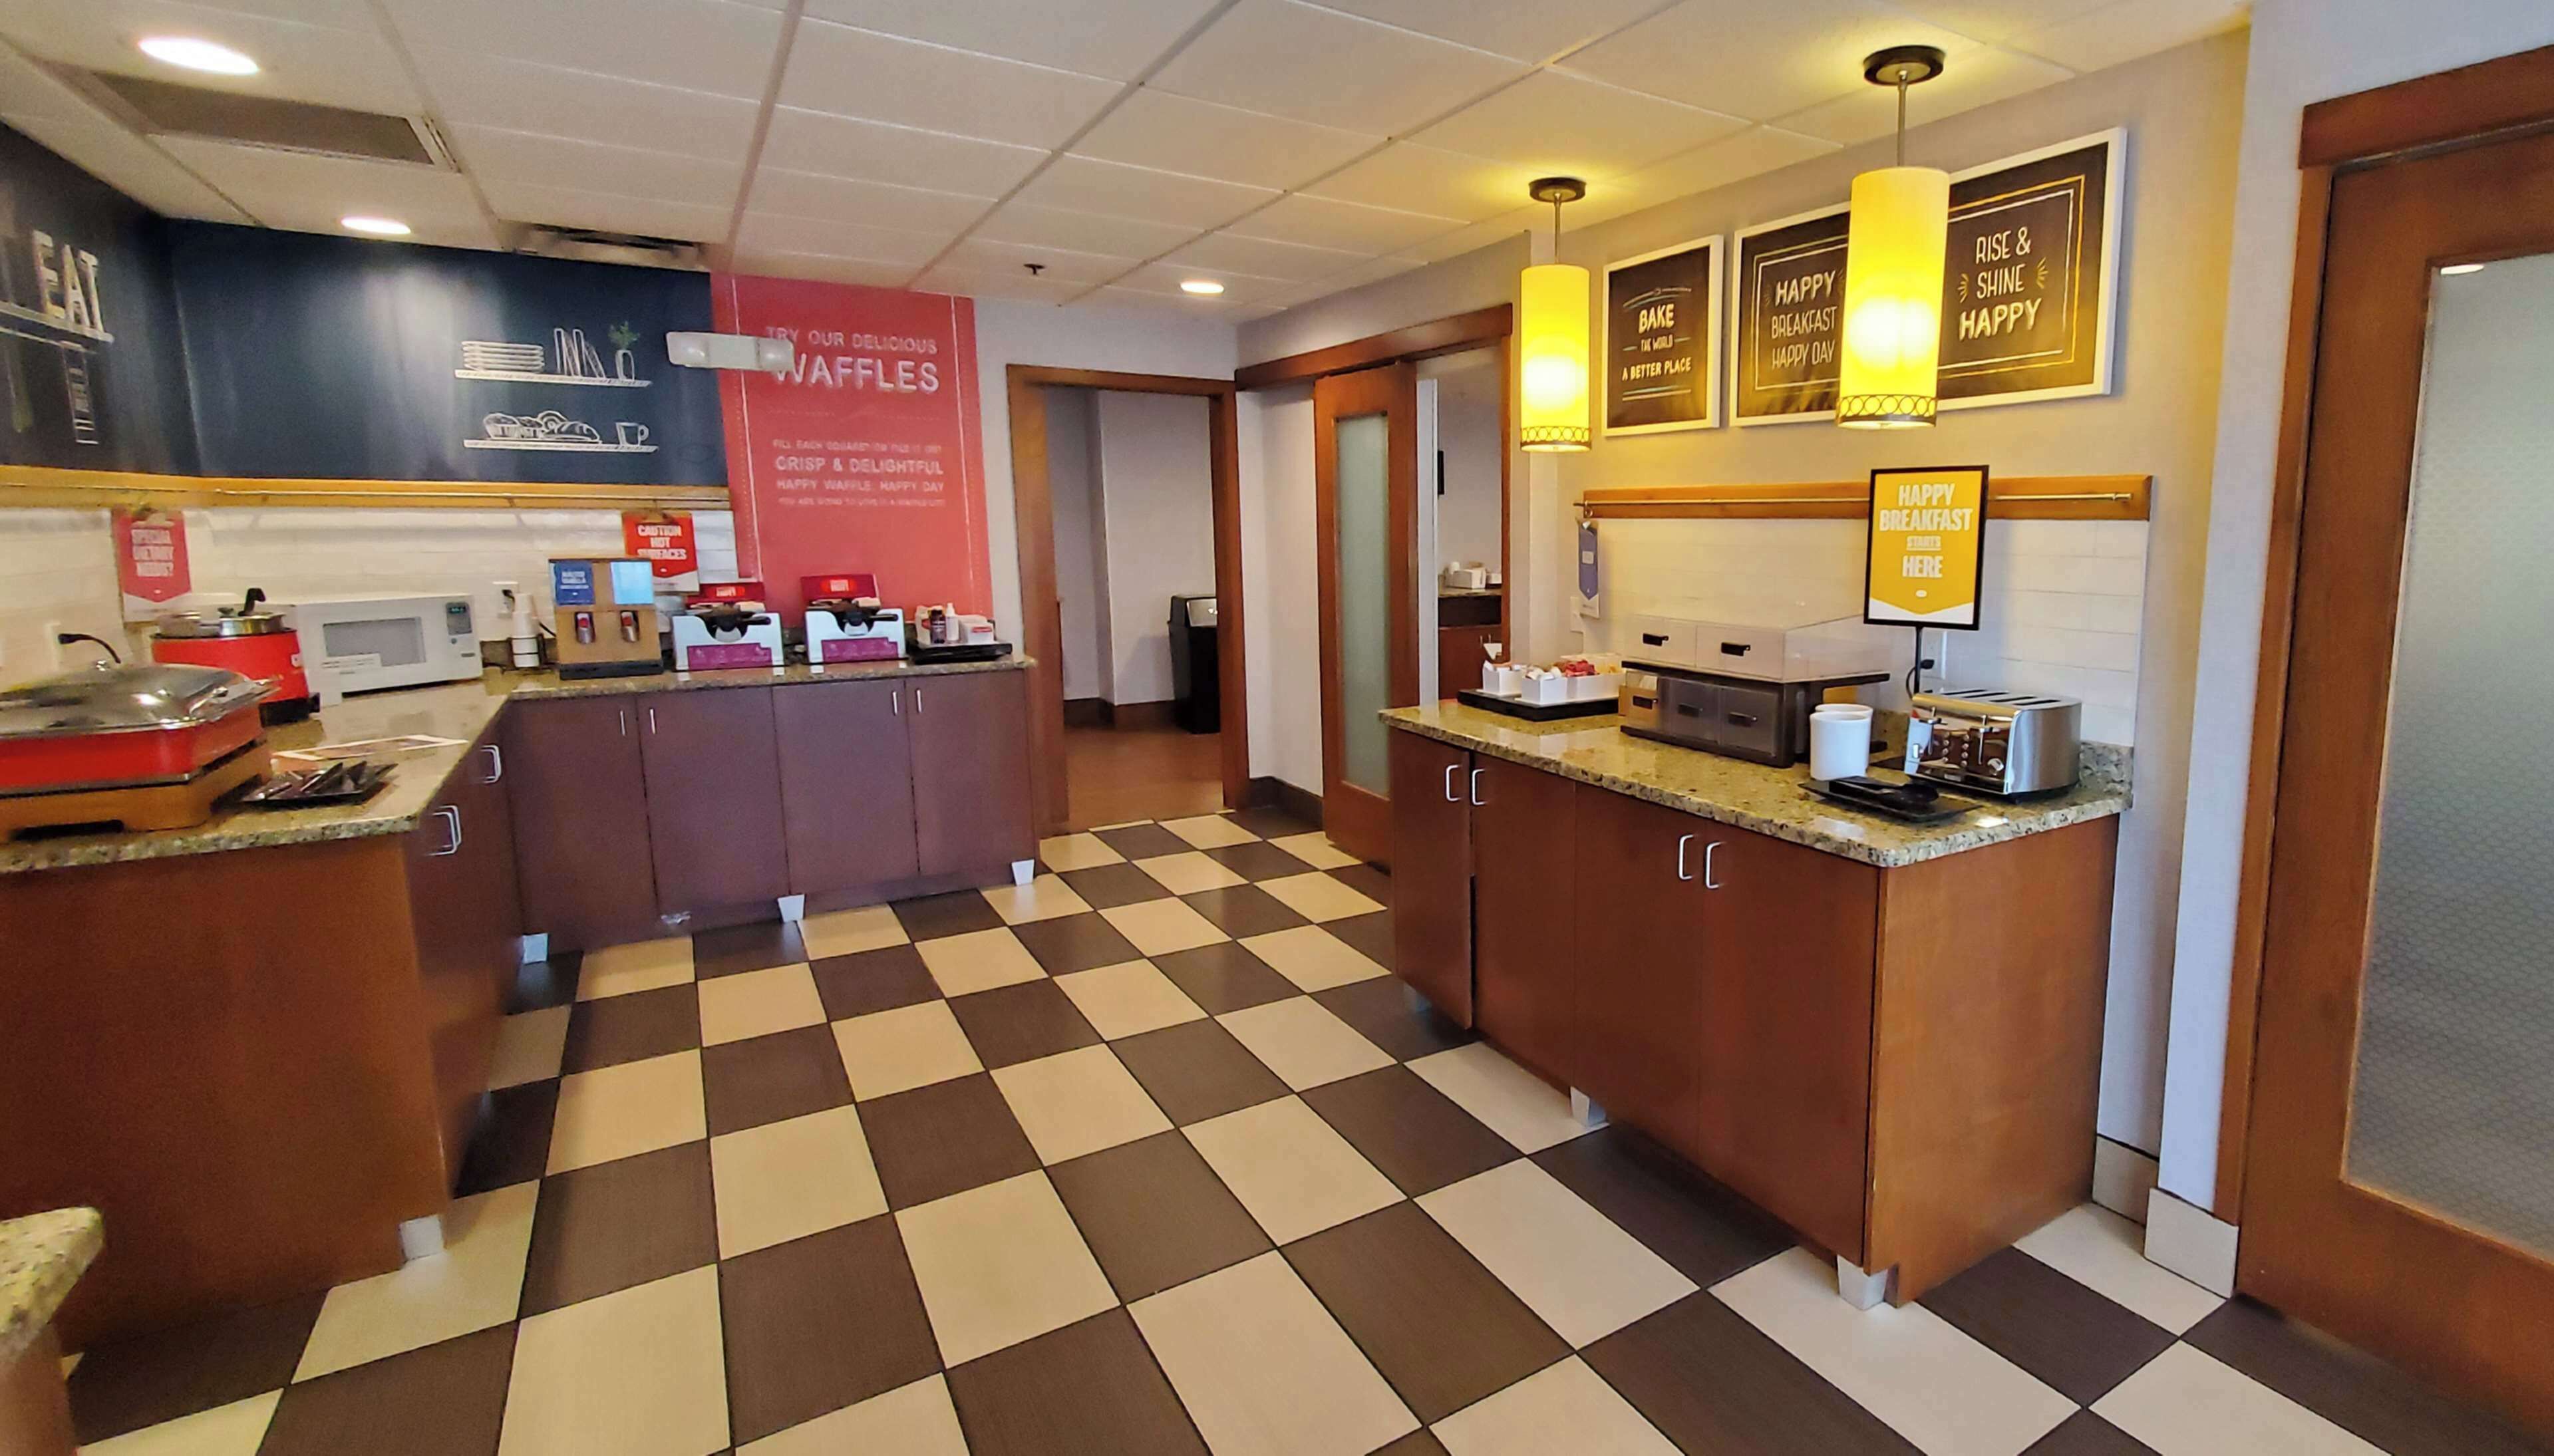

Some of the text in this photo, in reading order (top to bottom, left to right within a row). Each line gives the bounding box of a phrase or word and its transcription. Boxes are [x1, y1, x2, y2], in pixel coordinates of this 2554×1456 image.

[1976, 226, 2031, 264] RISE &
[33, 229, 104, 333] EAT
[1775, 270, 1836, 307] HAPPY
[1977, 263, 2026, 299] SHINE
[1639, 303, 1675, 334] BAKE
[1772, 306, 1837, 339] BREAKFAST
[1959, 298, 2042, 342] HAPPY
[808, 330, 844, 347] OUR
[852, 333, 937, 355] DELICIOUS
[1772, 339, 1835, 369] HAPPY DAY
[1622, 357, 1691, 381] A BETTER PLACE
[775, 456, 944, 476] CRISP & DELIGHTFUL
[776, 478, 817, 490] HAPPY
[880, 481, 917, 492] HAPPY
[923, 481, 944, 492] DAY
[1898, 483, 1955, 506] HAPPY
[637, 524, 682, 537] CAUTION
[1879, 508, 1973, 531] BREAKFAST
[1902, 555, 1943, 578] HERE
